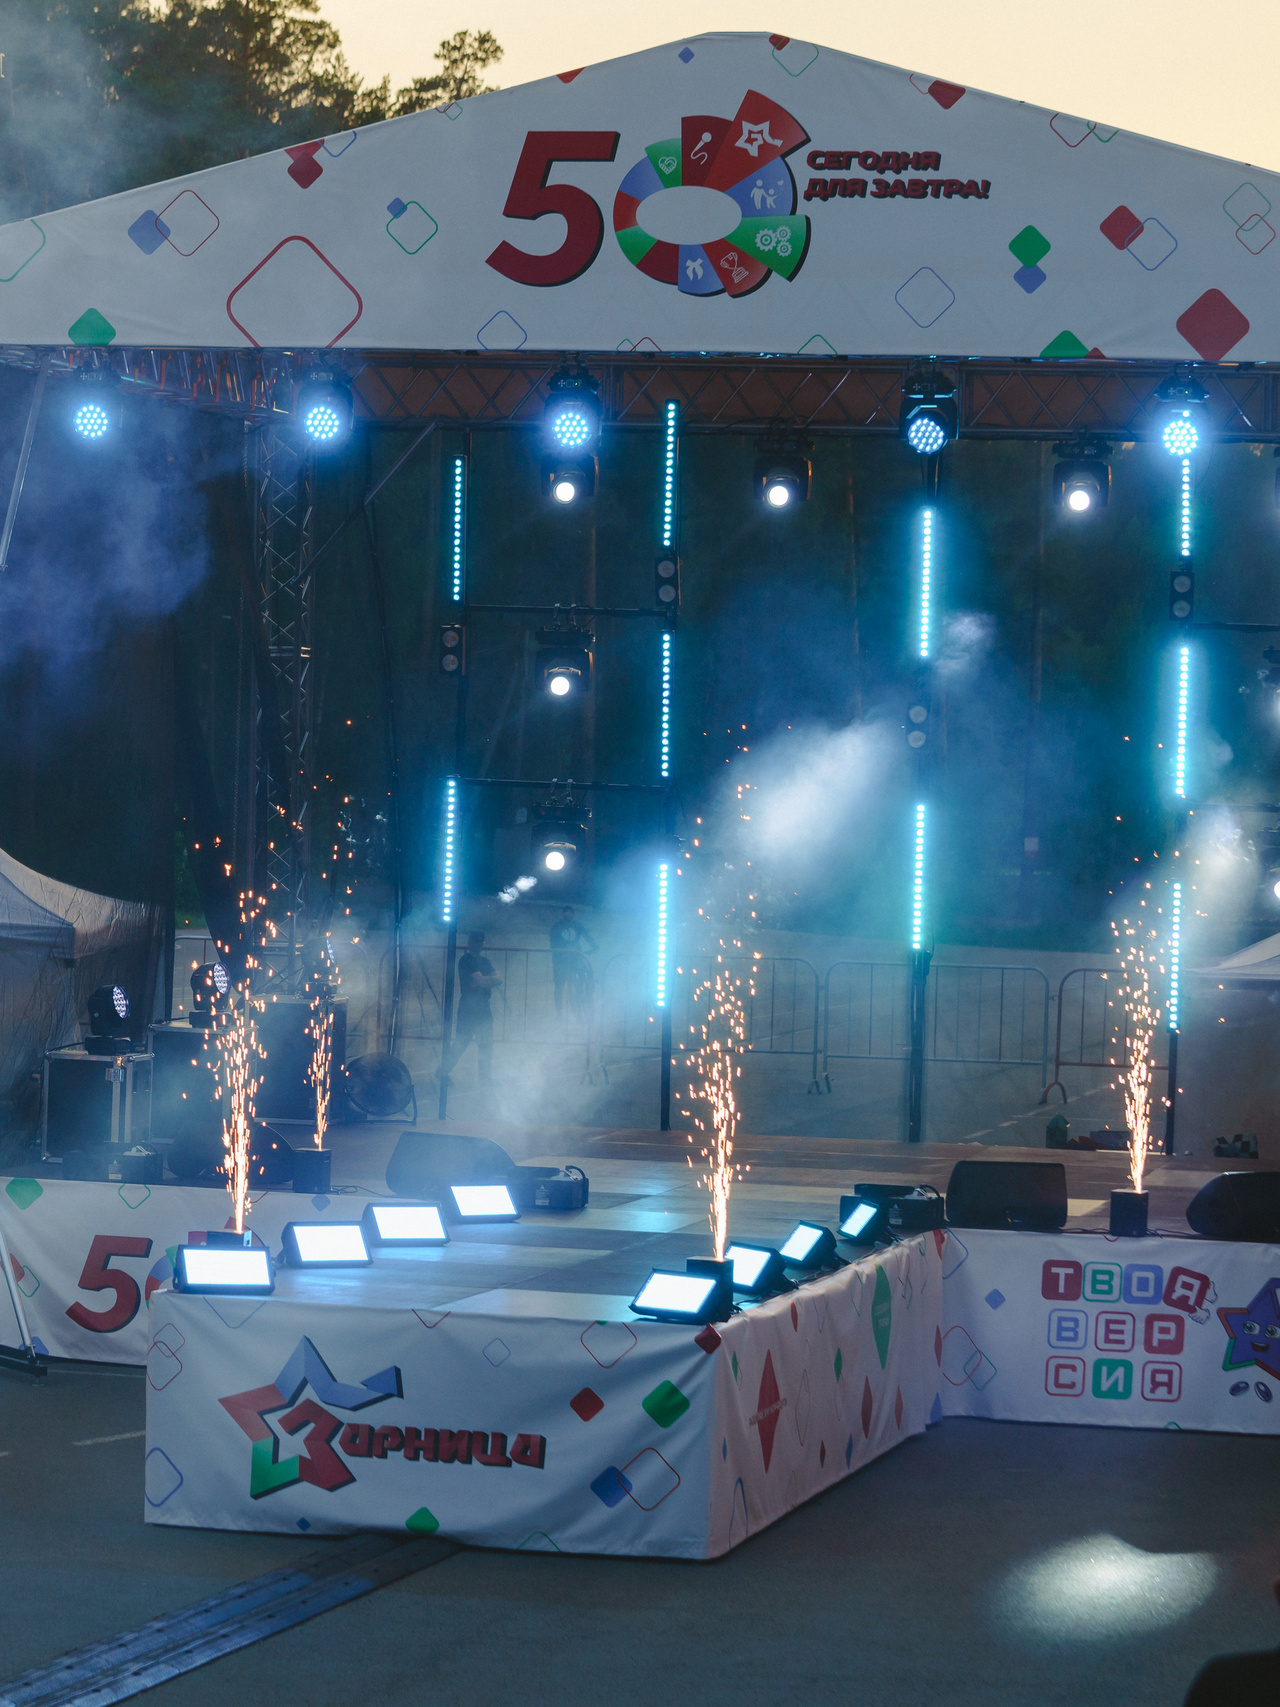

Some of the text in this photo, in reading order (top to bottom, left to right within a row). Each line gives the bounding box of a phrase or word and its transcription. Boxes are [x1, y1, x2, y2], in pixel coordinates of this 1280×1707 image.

[806, 150, 942, 175] СЕГОДНЯ
[803, 178, 992, 202] ДЛЯ ЗАВТРА!
[1048, 1264, 1205, 1309] ТВОЯ
[1053, 1313, 1179, 1350] ВЕР
[1051, 1360, 1176, 1398] СИЯ
